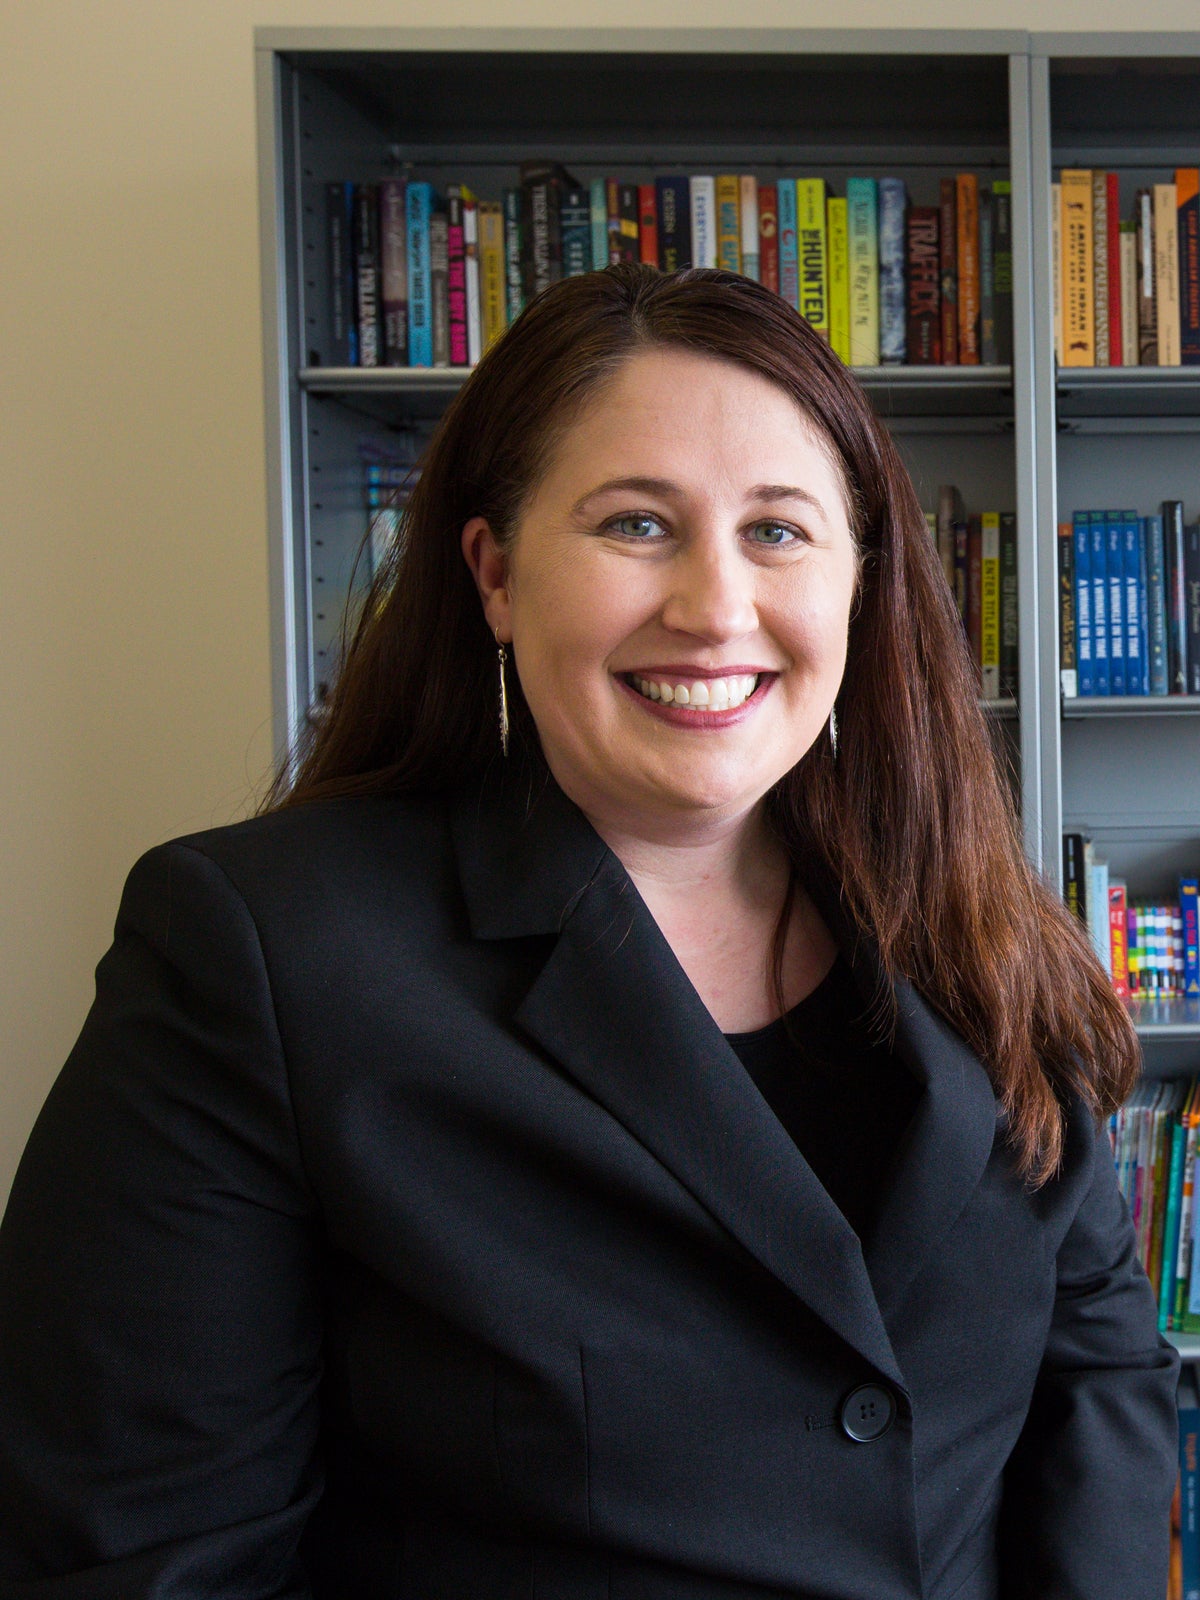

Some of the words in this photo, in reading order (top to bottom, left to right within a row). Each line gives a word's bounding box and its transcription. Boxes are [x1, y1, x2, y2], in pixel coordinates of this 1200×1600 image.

[910, 216, 938, 316] TRAFFICK
[1078, 223, 1086, 283] AMERICAN
[1188, 238, 1198, 281] AMERICAN
[449, 262, 465, 288] THE
[803, 241, 824, 324] HUNTED
[1079, 287, 1087, 330] INDIAN
[984, 560, 996, 598] ENTER
[985, 601, 996, 630] TITLE
[1079, 588, 1088, 626] WRINKLE
[1094, 587, 1104, 625] WRINKLE
[1111, 586, 1120, 624] WRINKLE
[1128, 586, 1137, 624] WRINKLE
[1080, 628, 1088, 637] IN
[1095, 627, 1104, 636] IN
[1112, 626, 1120, 635] IN
[1128, 626, 1137, 635] IN
[985, 634, 996, 664] HERE
[1080, 640, 1090, 660] TIME
[1096, 639, 1105, 659] TIME
[1112, 638, 1122, 658] TIME
[1128, 638, 1138, 658] TIME
